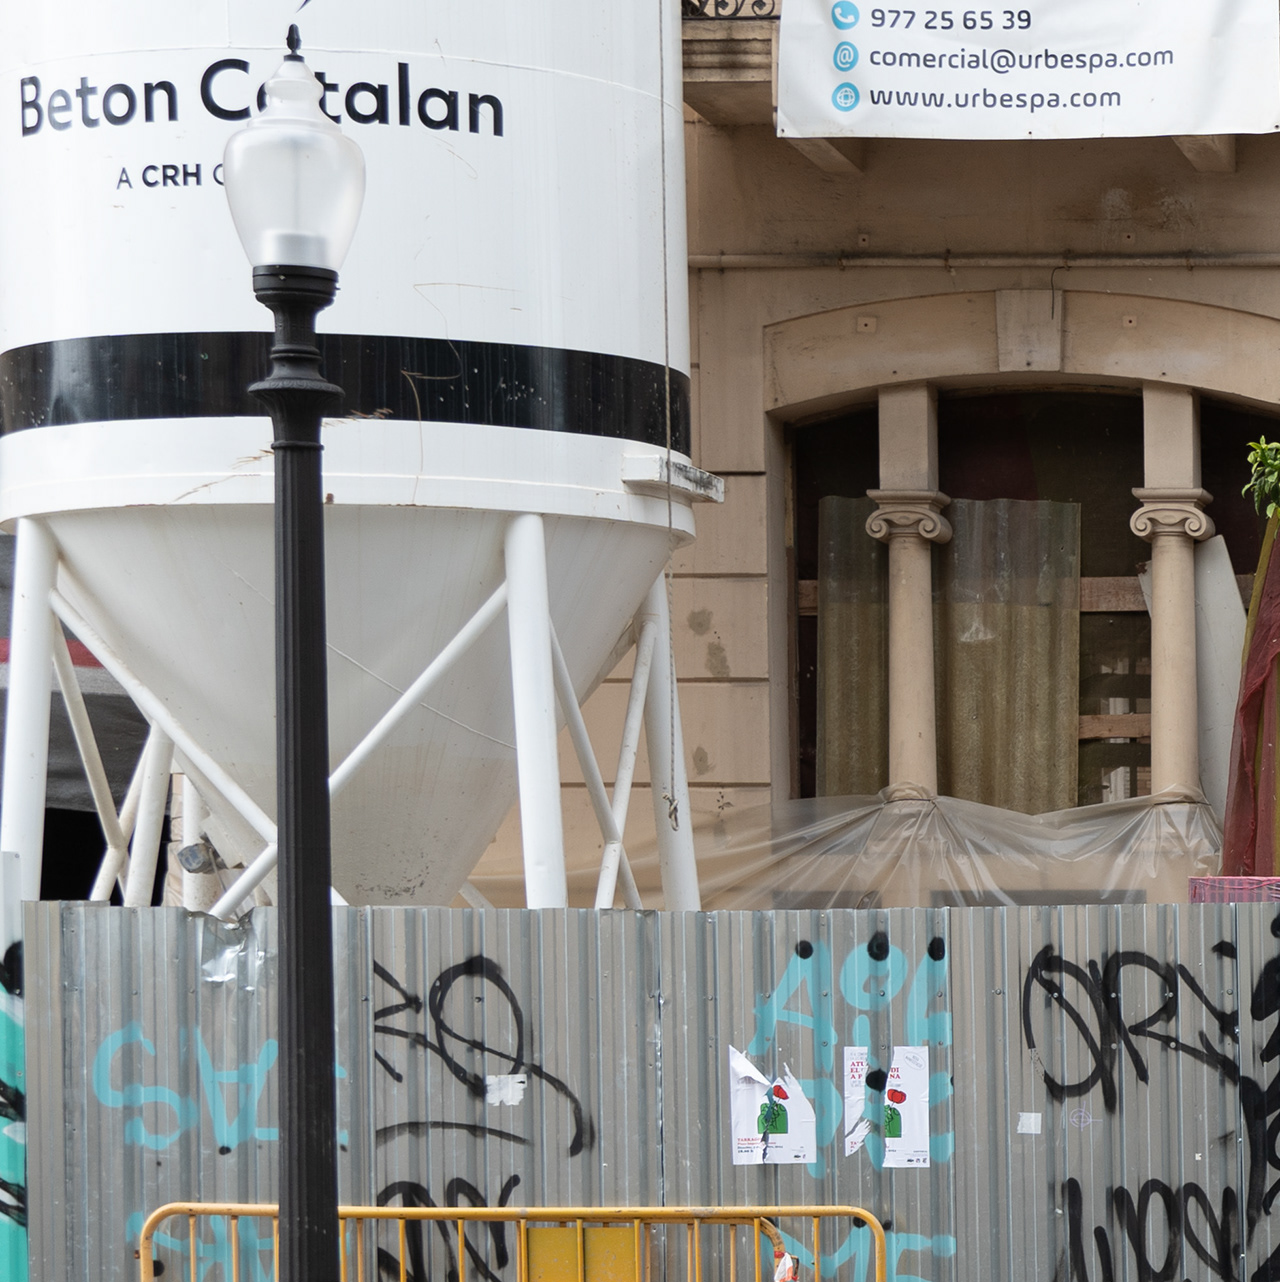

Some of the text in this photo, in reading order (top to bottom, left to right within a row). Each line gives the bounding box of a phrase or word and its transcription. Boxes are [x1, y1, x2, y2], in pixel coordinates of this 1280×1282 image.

[871, 9, 1032, 30] 977 25 65 39
[869, 48, 1174, 74] comercial@urbespa.com
[20, 58, 504, 137] Beton Ctalan
[870, 88, 1122, 114] www.urbespa.com
[116, 167, 133, 190] A
[141, 163, 201, 188] CRH
